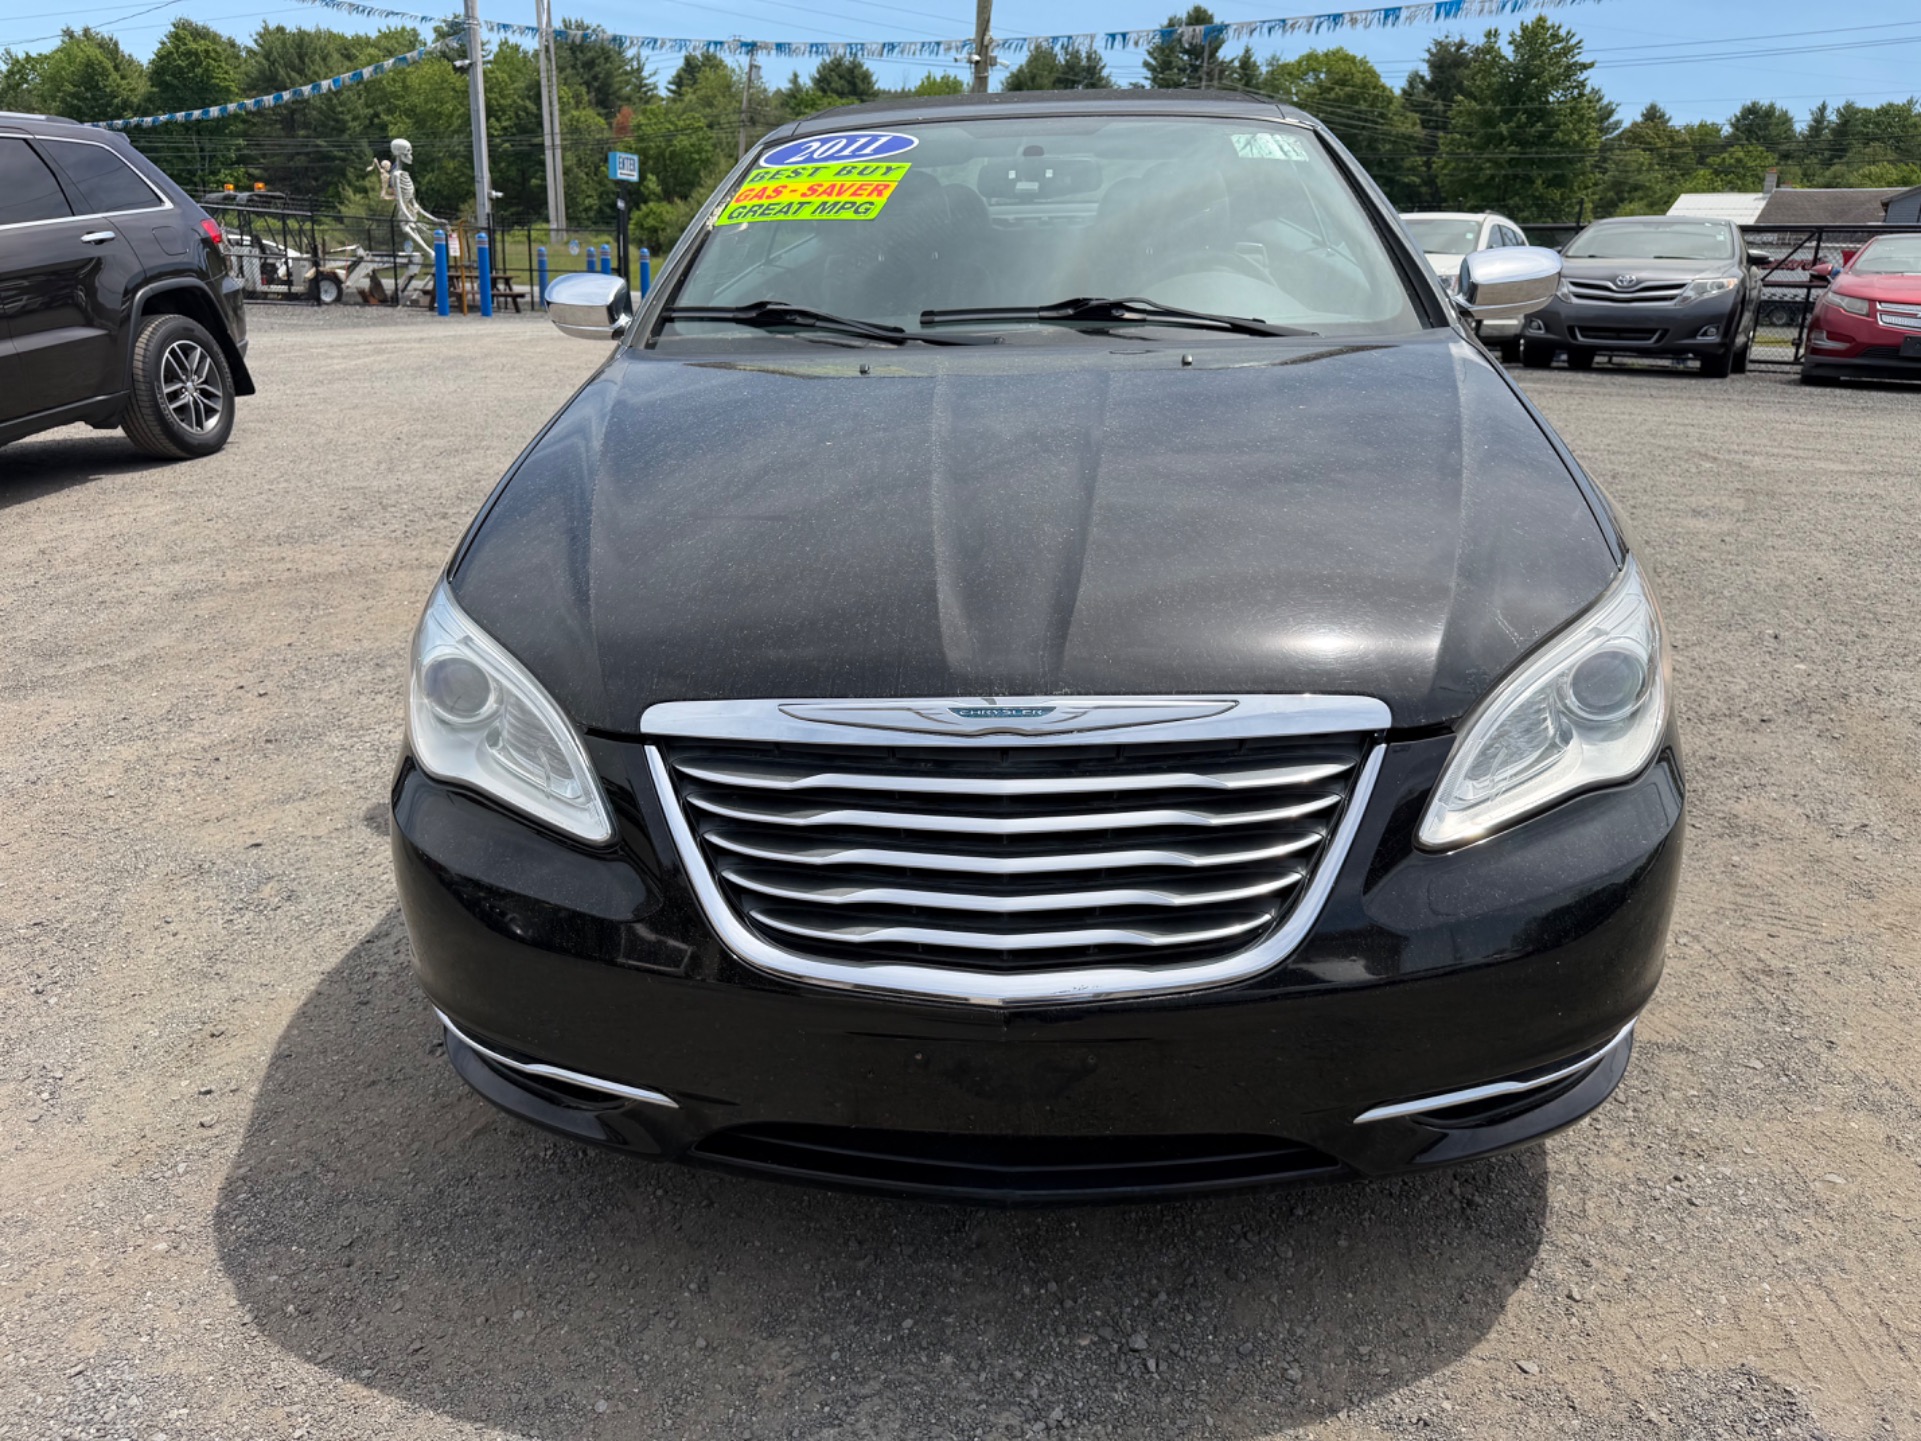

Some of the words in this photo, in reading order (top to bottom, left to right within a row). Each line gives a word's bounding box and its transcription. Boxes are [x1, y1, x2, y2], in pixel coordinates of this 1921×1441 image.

[784, 135, 893, 164] 2011
[618, 155, 636, 172] ENTER
[748, 166, 829, 184] BEST
[833, 165, 907, 177] BUY
[727, 201, 810, 220] GREAT
[811, 201, 876, 216] MPG
[959, 708, 1043, 716] CHRYSLER
